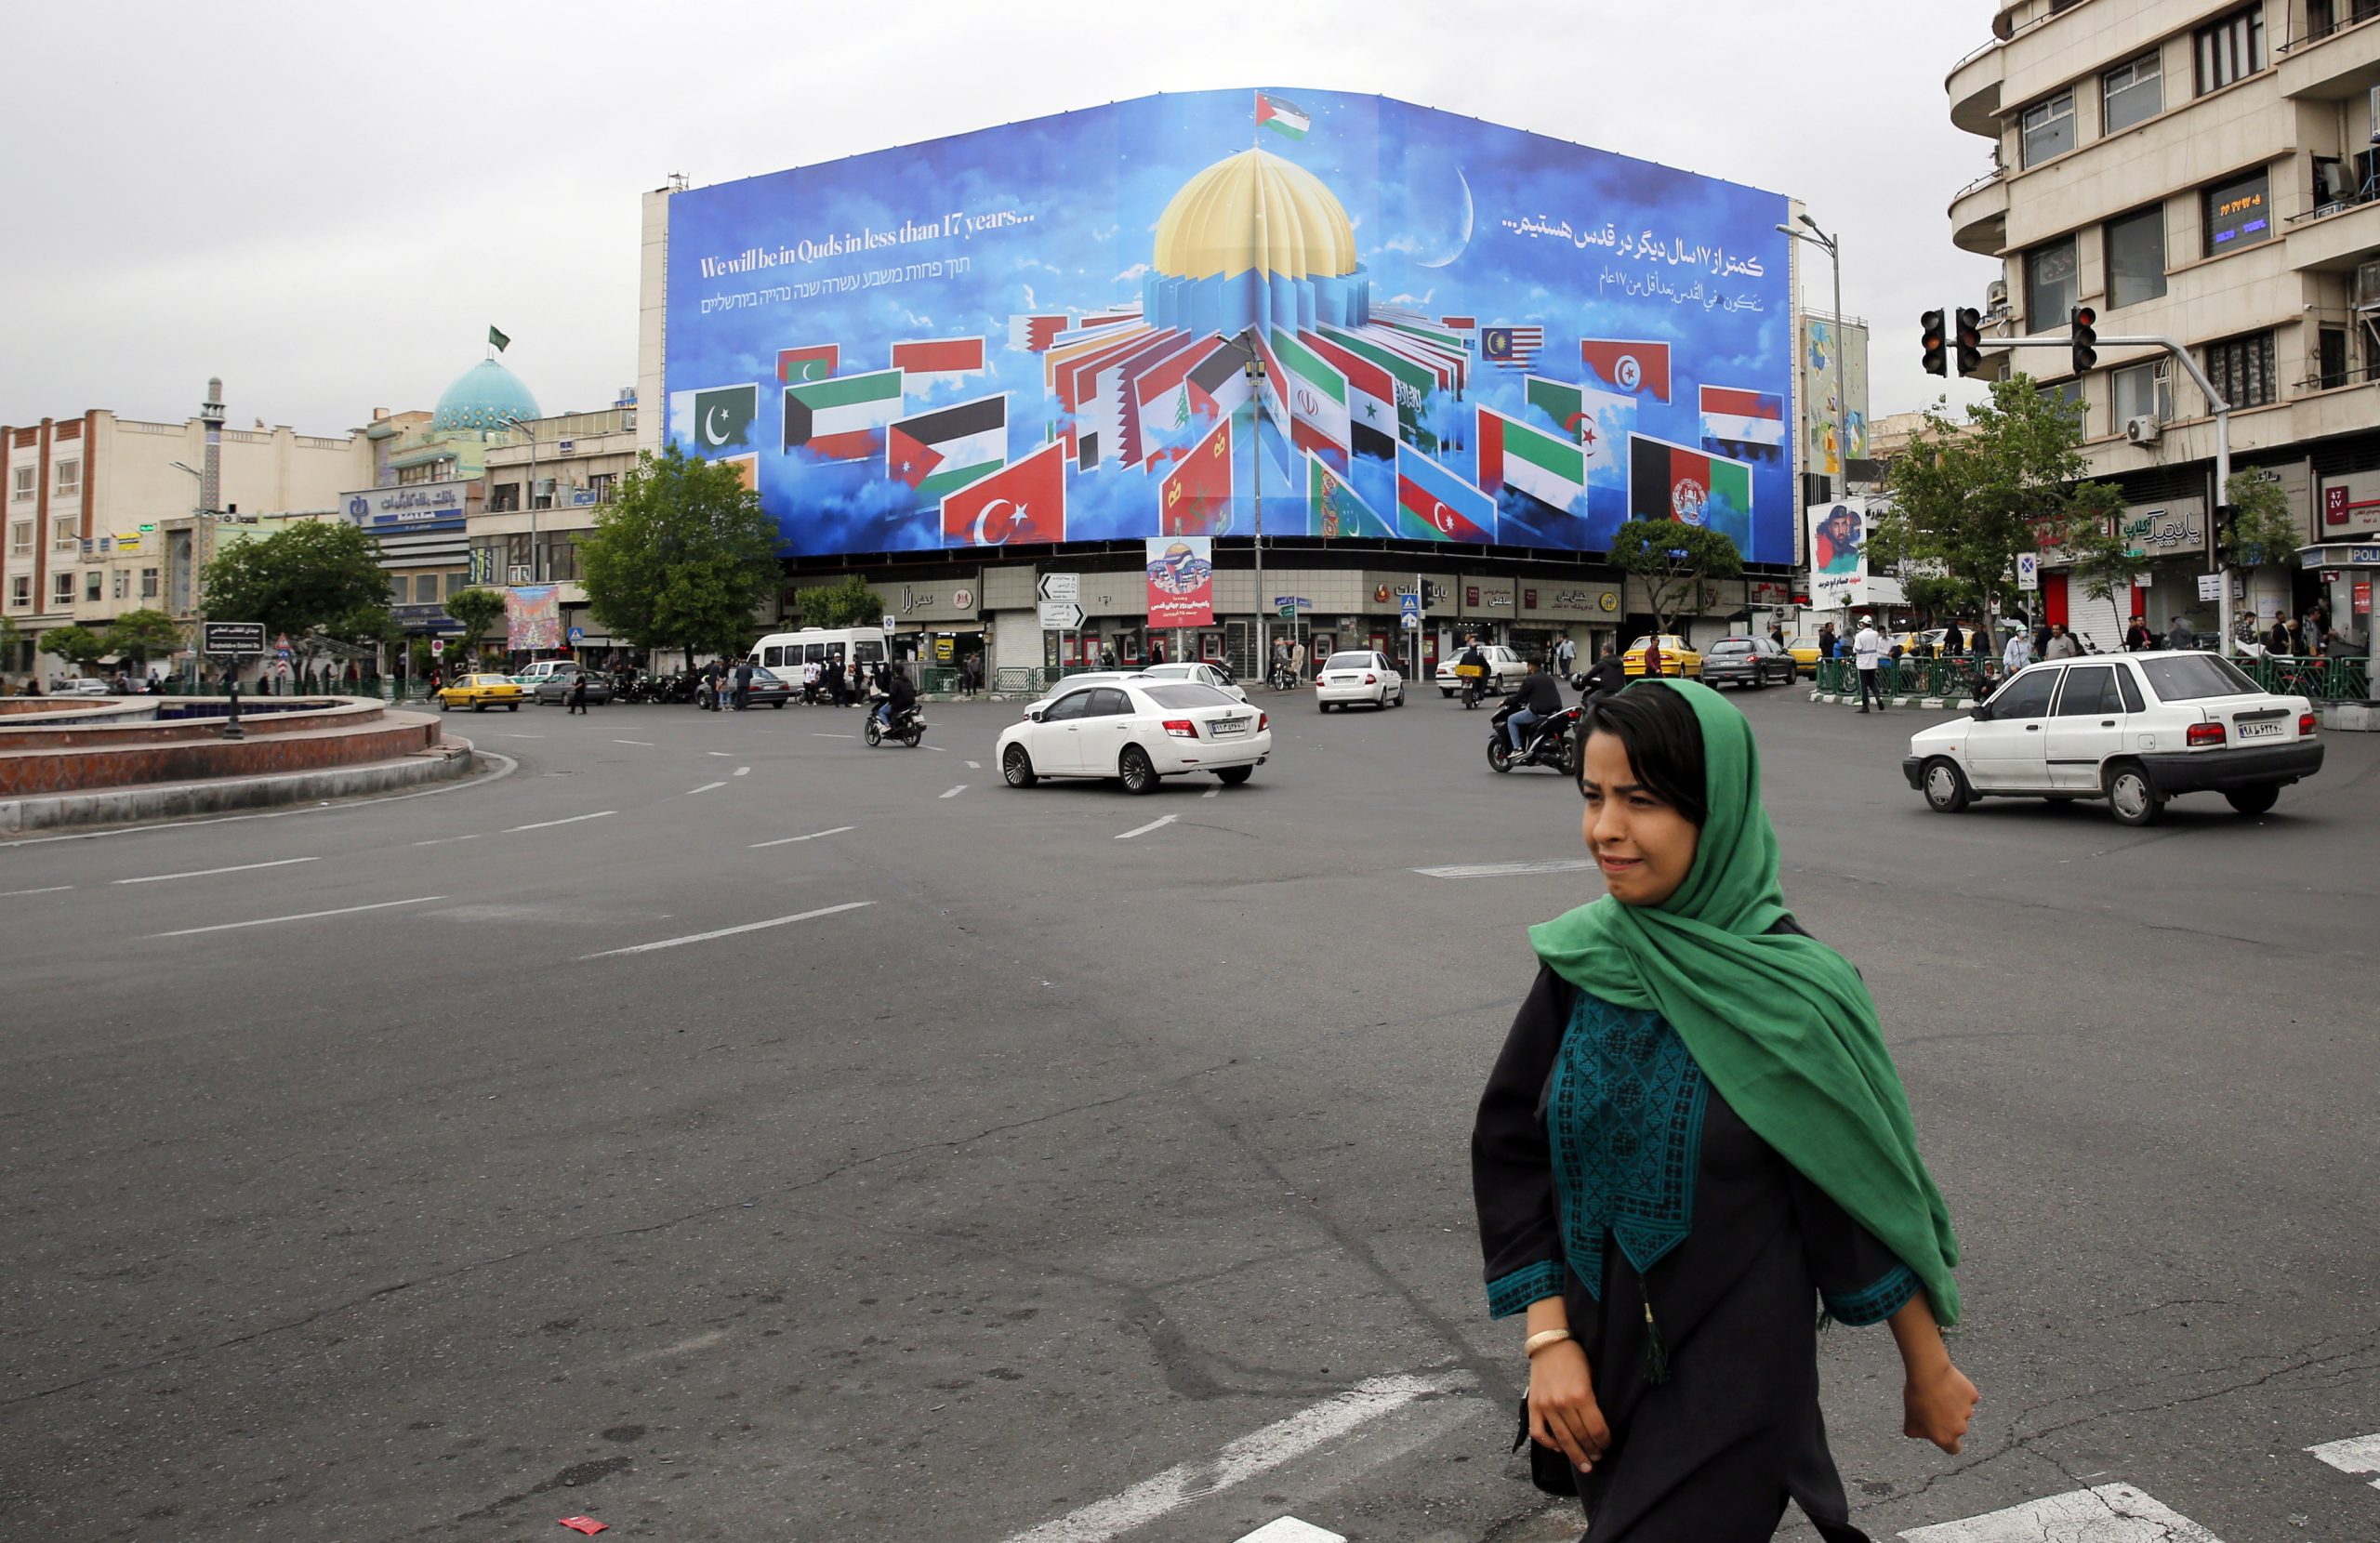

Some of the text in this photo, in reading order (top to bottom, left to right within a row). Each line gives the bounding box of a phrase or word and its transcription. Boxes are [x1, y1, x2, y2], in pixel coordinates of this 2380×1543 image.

[700, 210, 1035, 279] We will be in Quds in less than 17 years...
[1502, 215, 1764, 277] کمتر از ۱۷ سال دیگر در قدس هستیم...
[862, 268, 903, 288] משבע
[906, 261, 942, 281] פחות
[945, 257, 970, 279] תוך
[794, 281, 820, 299] שנה
[823, 274, 860, 294] עשרה
[1599, 265, 1616, 295] عام
[1626, 280, 1642, 296] من
[760, 286, 790, 305] נהייה
[2353, 549, 2379, 561] POLI
